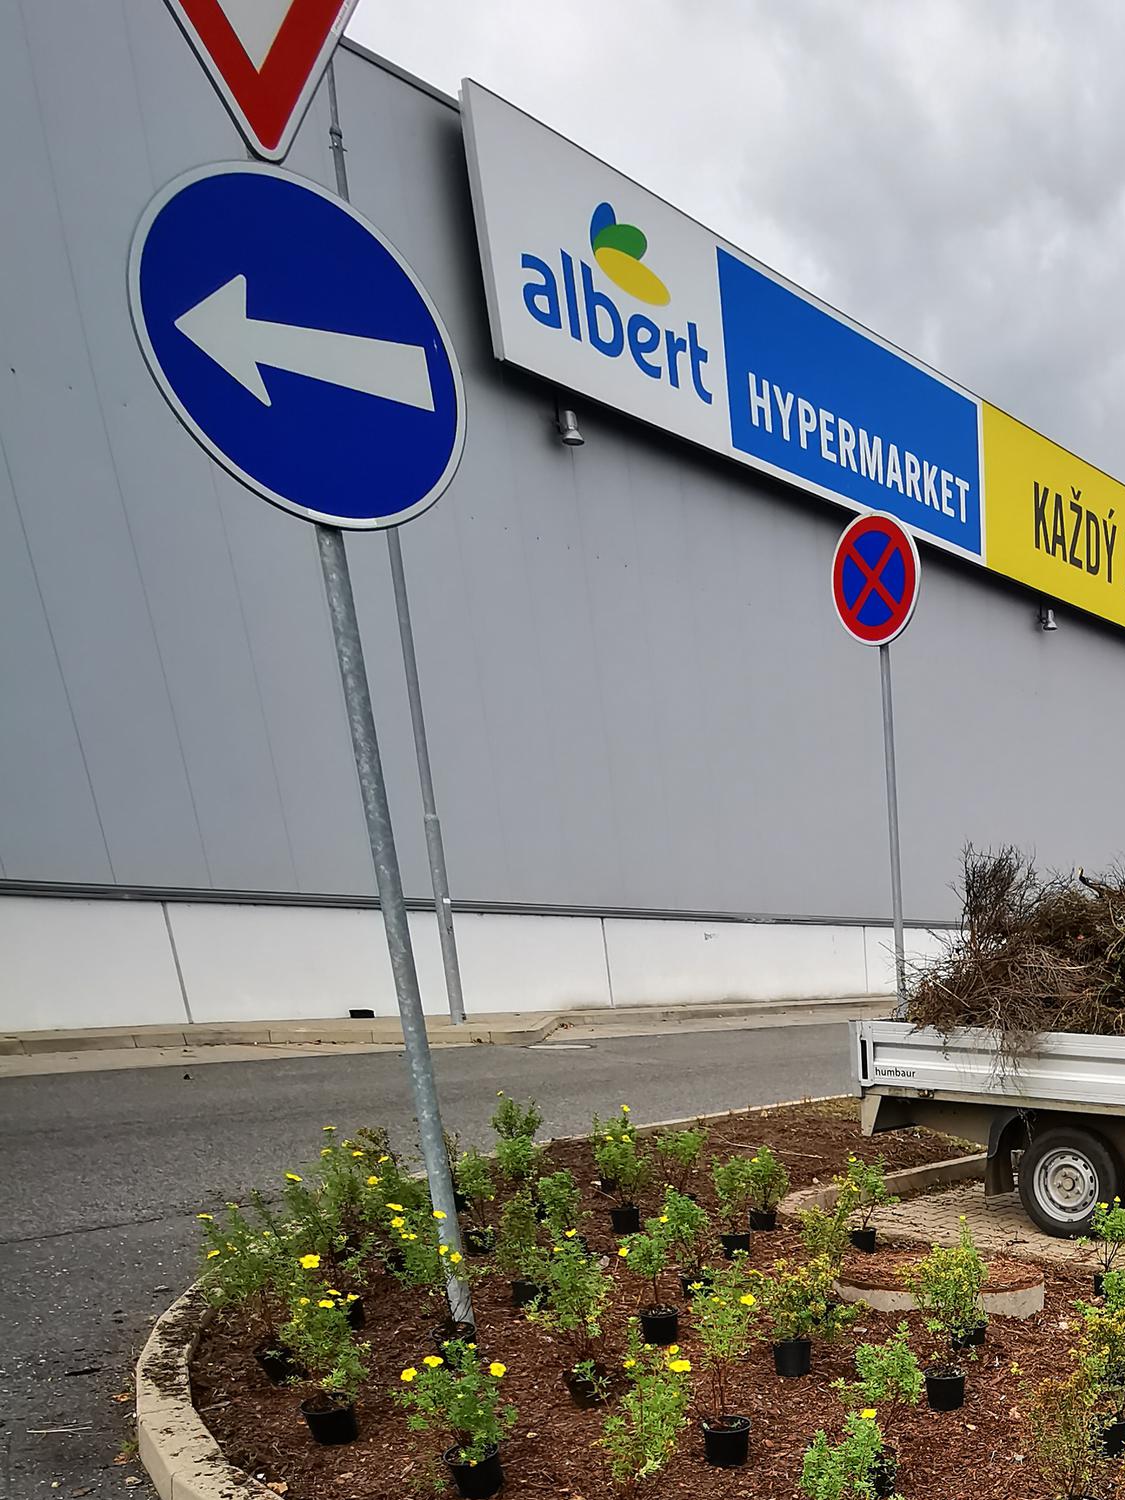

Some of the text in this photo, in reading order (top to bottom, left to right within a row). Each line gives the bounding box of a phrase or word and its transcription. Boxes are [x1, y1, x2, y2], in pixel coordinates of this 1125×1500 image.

[521, 248, 713, 406] albert
[748, 371, 970, 524] HYPERMARKET
[1033, 480, 1117, 584] KAŽDÝ
[875, 1067, 916, 1078] humbaur
